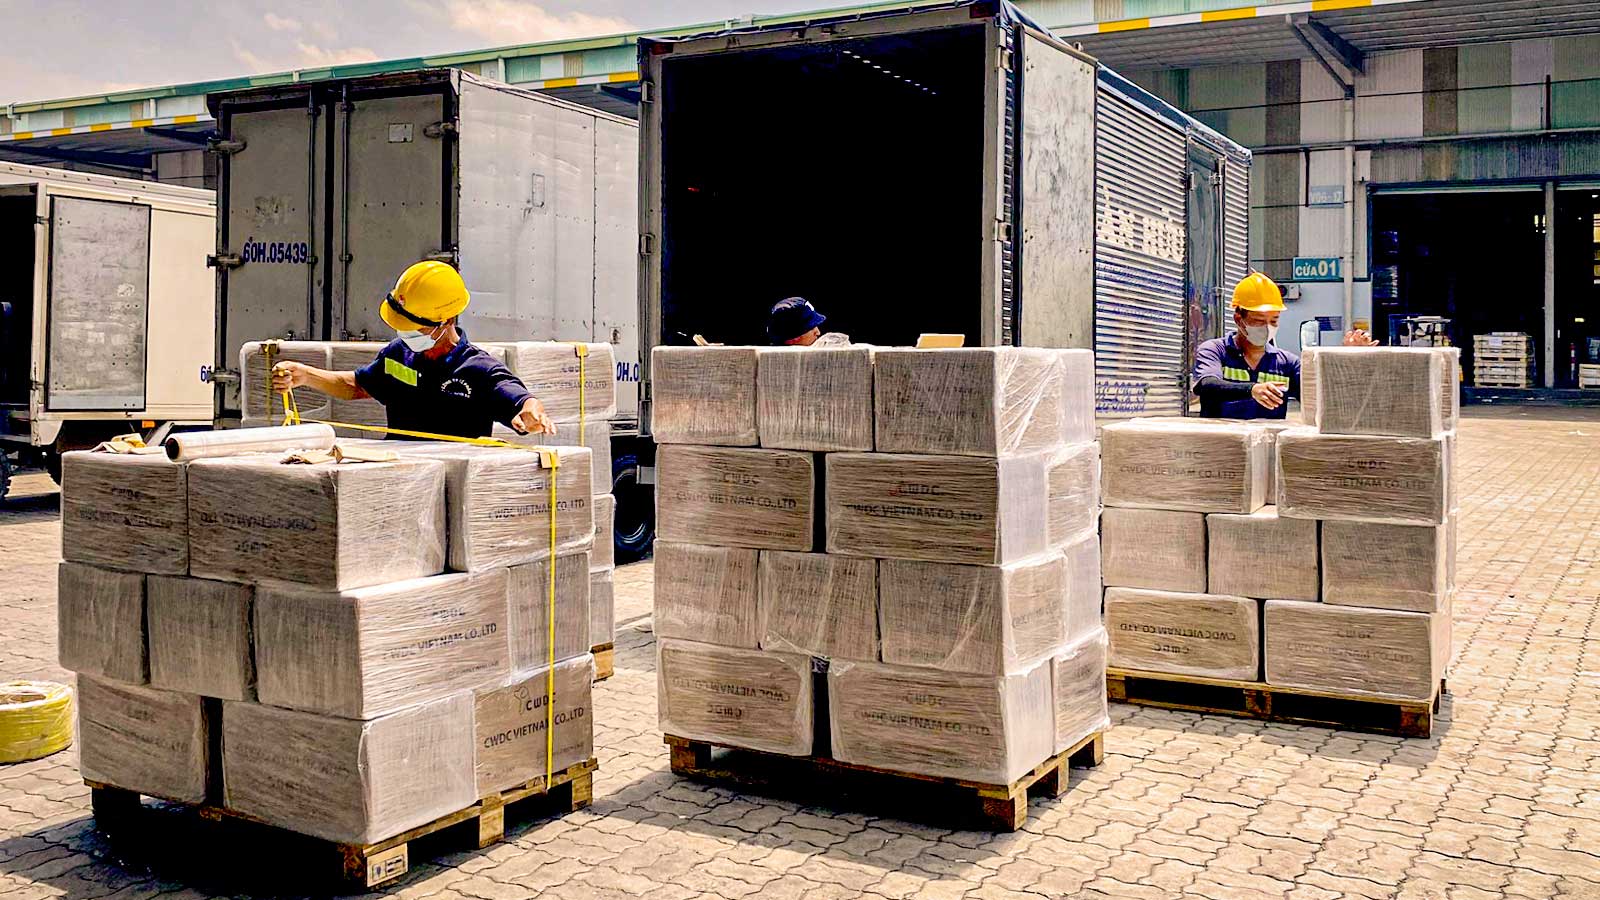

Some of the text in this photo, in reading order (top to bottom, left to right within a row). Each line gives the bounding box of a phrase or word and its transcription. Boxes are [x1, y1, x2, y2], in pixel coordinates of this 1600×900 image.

[243, 242, 308, 264] 60H.05439
[1318, 260, 1337, 276] 01
[483, 730, 513, 749] CWDC
